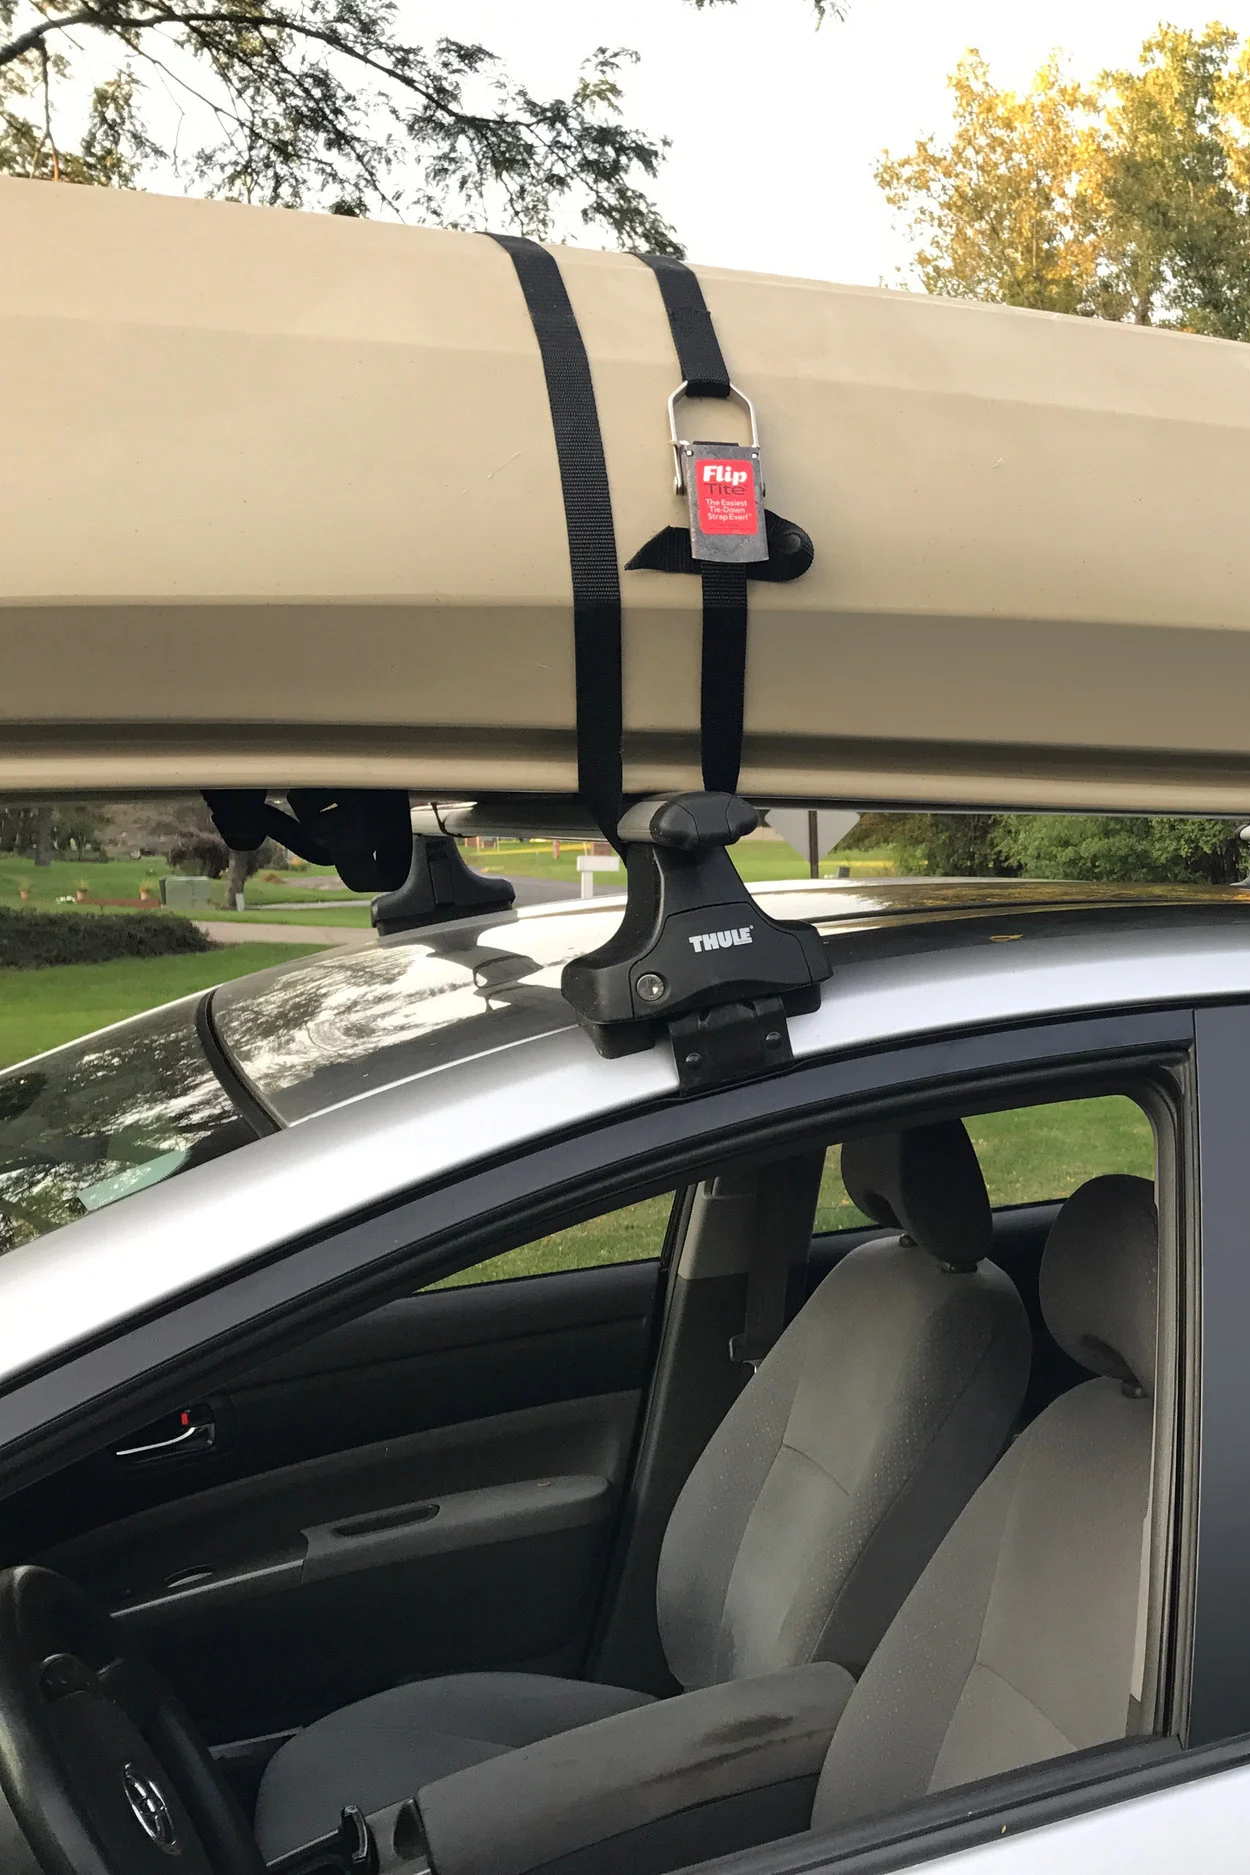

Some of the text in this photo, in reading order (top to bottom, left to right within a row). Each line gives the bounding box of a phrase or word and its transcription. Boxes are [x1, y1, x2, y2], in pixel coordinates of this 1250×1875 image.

[703, 465, 747, 486] Flip
[704, 483, 746, 495] Tite
[705, 498, 747, 507] The Easiest
[707, 512, 728, 522] Strap
[688, 927, 753, 953] THULE
